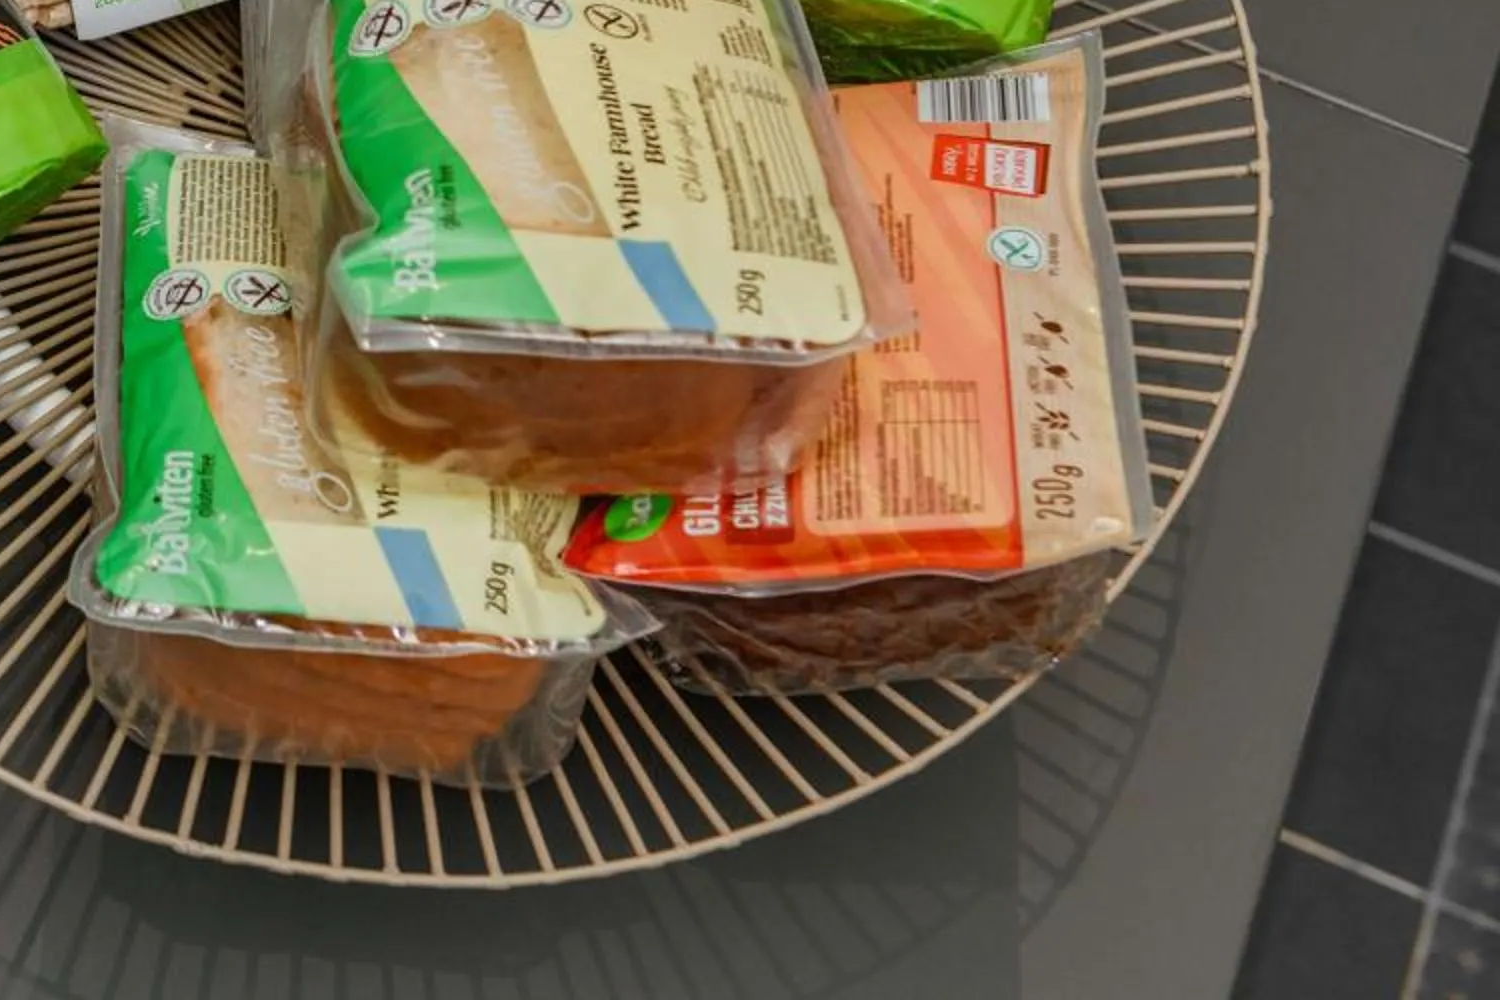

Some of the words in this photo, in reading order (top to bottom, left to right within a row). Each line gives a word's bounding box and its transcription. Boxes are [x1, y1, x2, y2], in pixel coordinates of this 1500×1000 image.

[589, 42, 633, 156] Farmhouse
[630, 101, 666, 165] Bread
[614, 162, 642, 231] White
[1032, 464, 1085, 521] 250g
